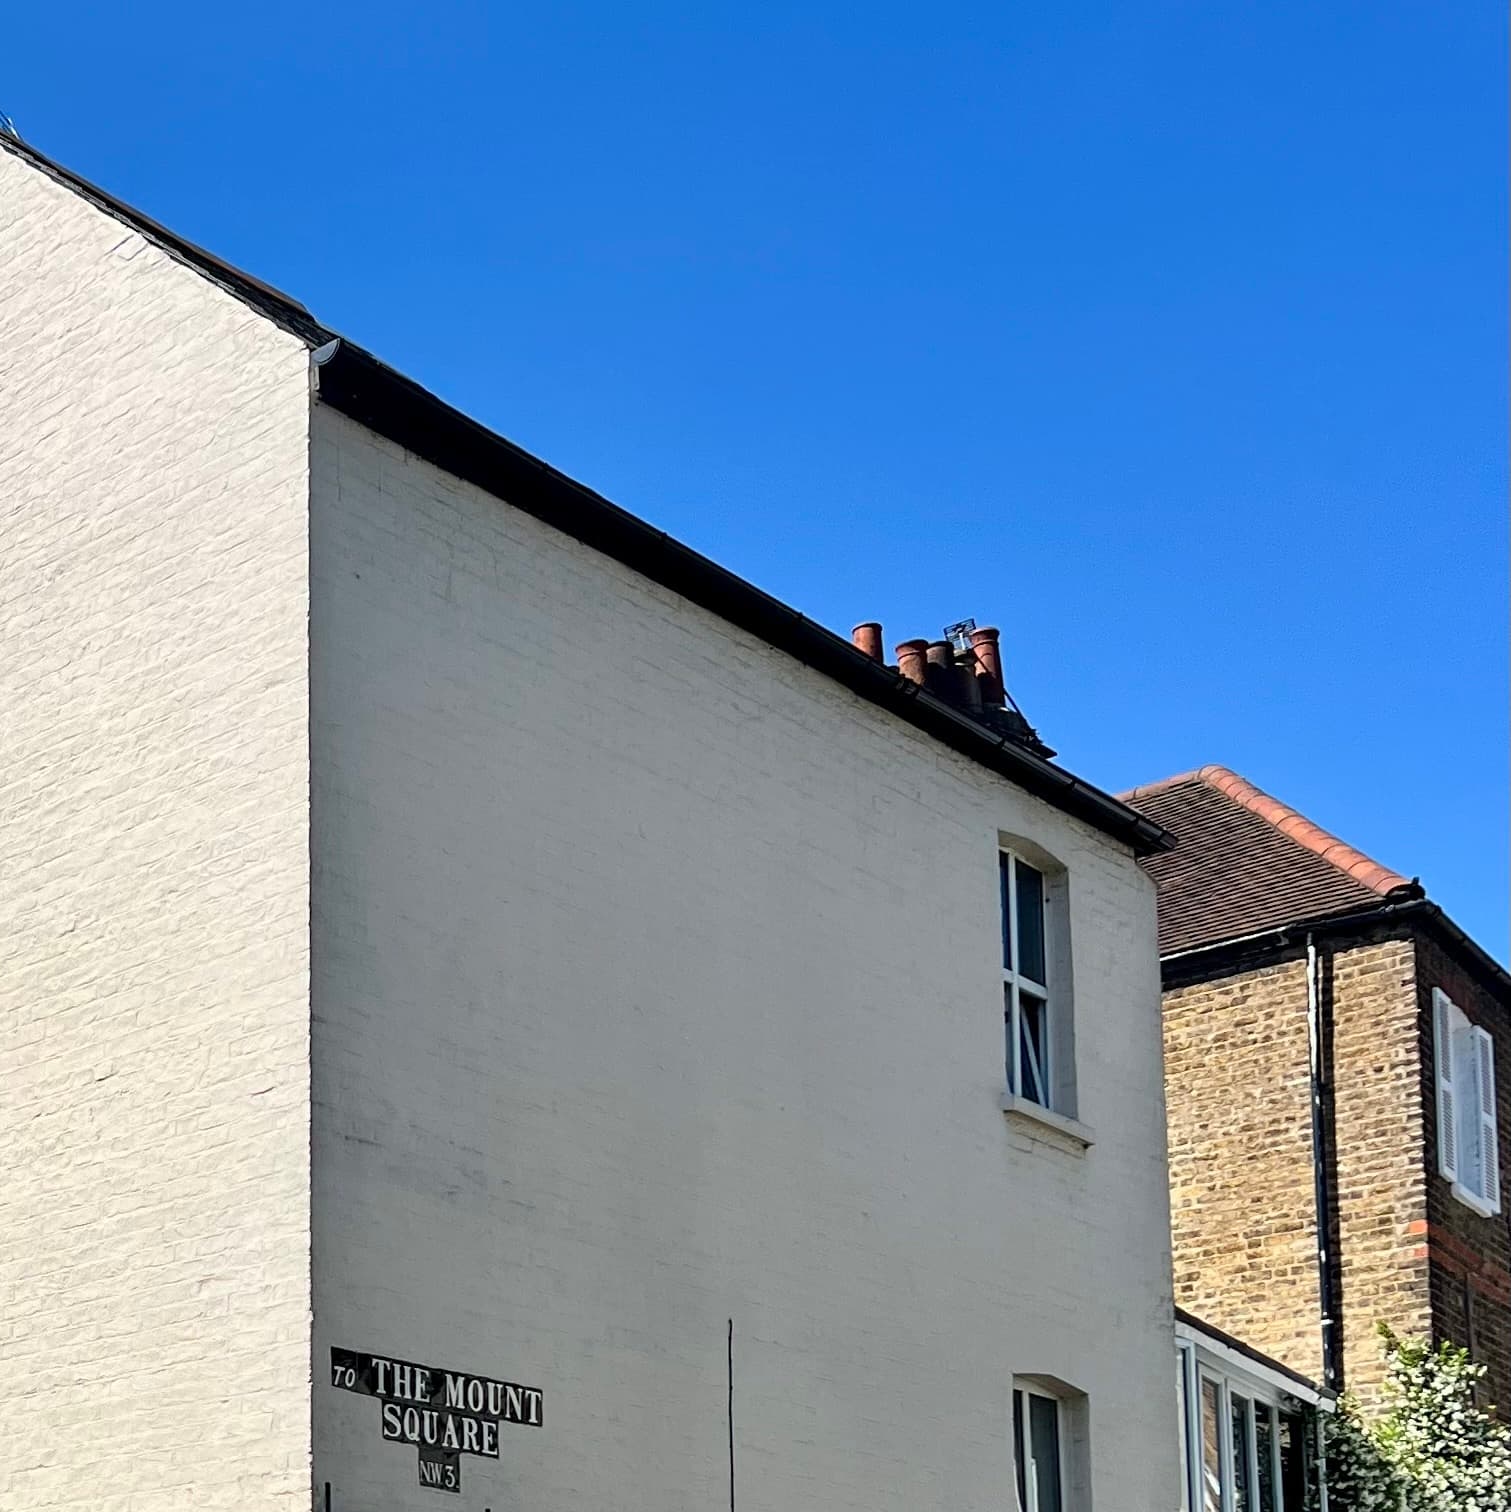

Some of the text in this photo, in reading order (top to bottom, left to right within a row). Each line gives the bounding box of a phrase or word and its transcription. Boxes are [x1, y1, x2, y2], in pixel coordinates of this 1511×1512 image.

[333, 1357, 543, 1424] TO THE MOUNT
[383, 1403, 499, 1456] SQUARE
